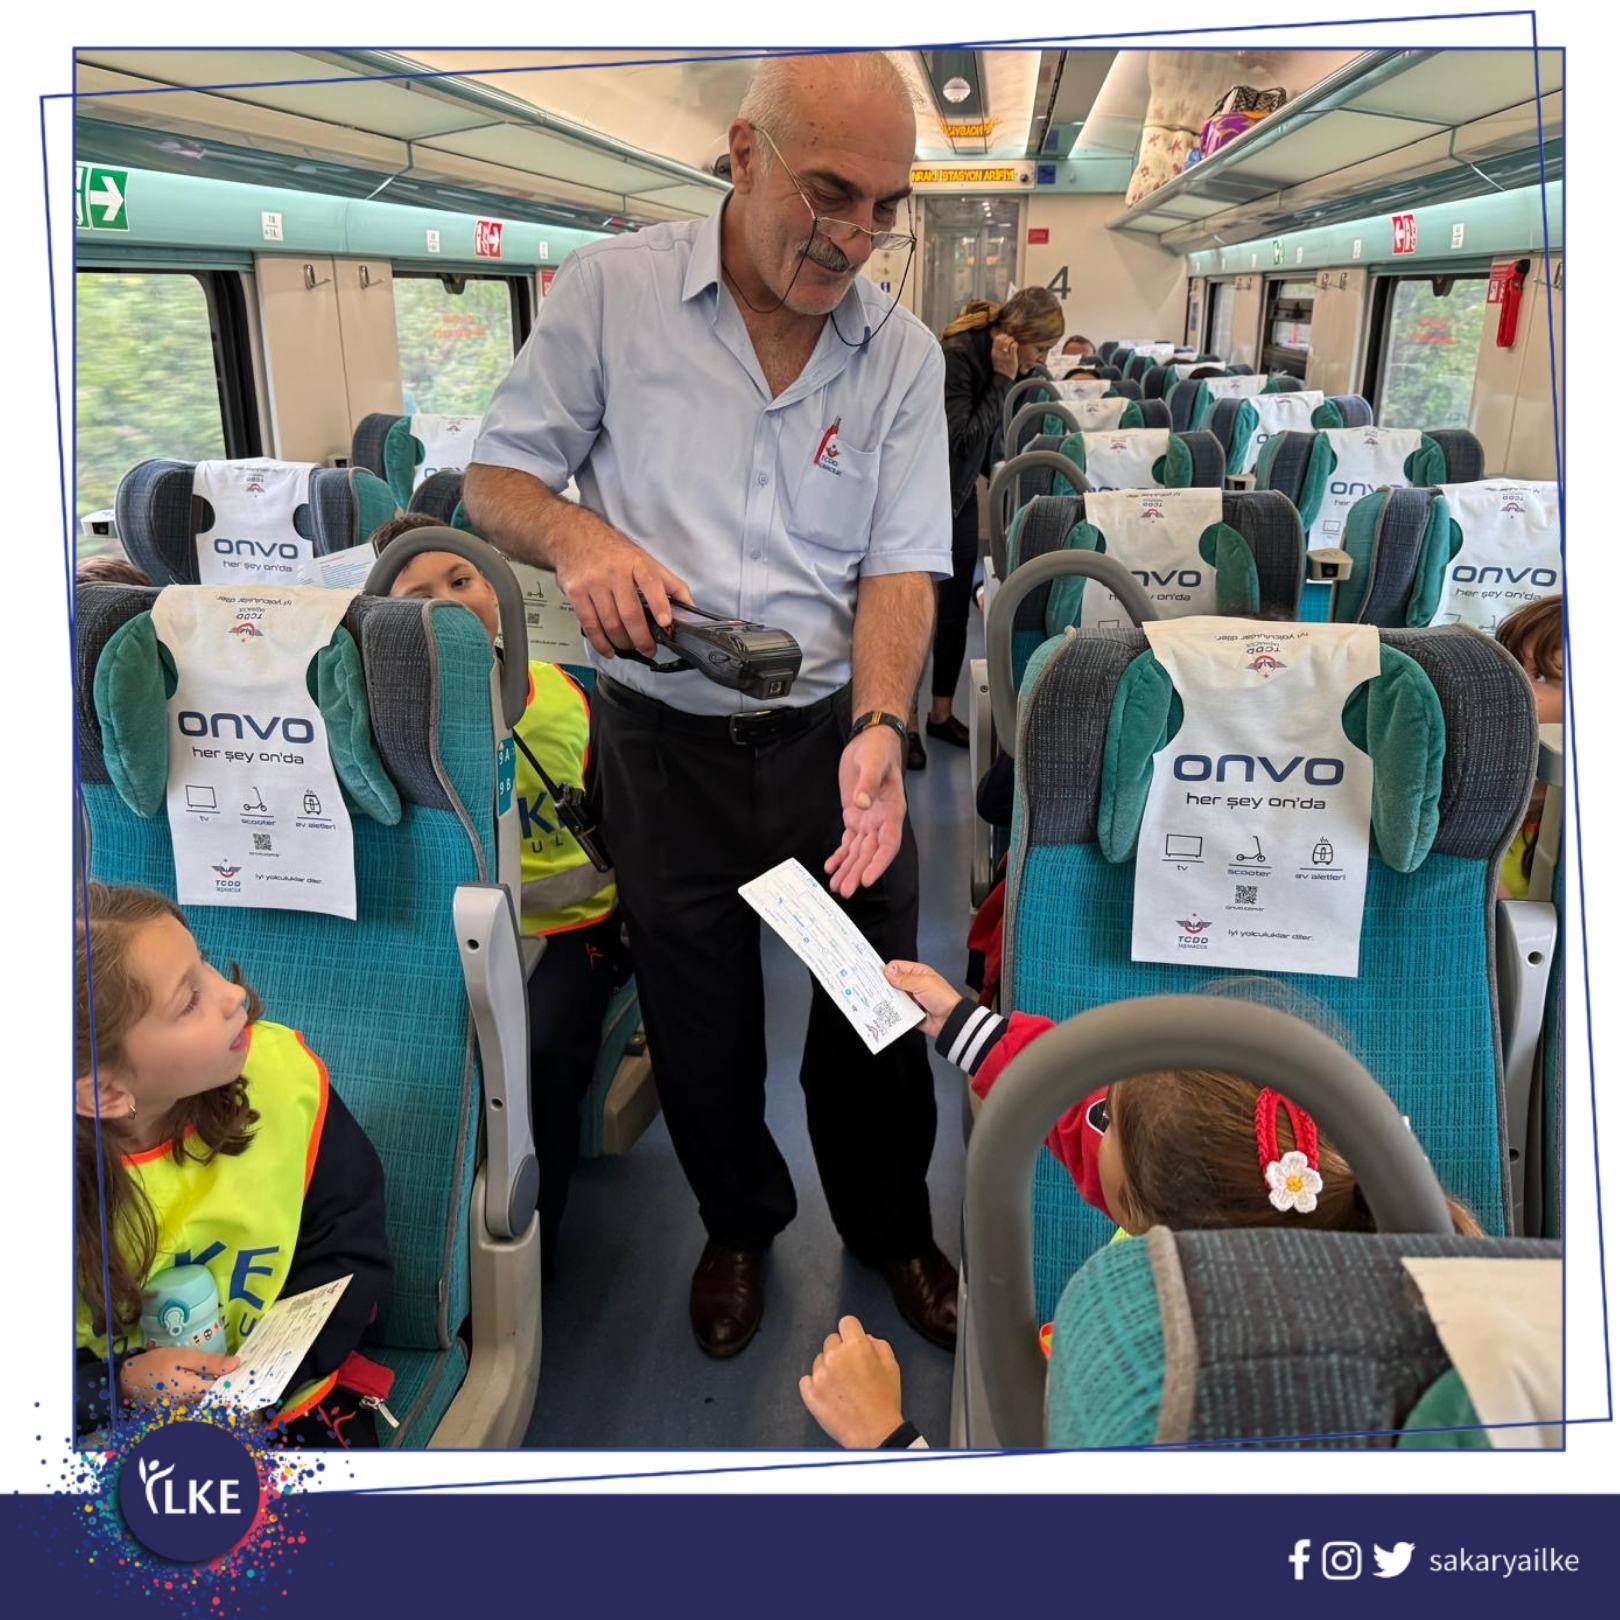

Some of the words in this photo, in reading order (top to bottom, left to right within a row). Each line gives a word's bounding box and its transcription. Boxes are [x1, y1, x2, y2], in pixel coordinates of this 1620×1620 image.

[1047, 265, 1071, 299] 4
[214, 539, 298, 559] onvo
[223, 559, 242, 568] her
[1452, 565, 1557, 588] onvo
[1157, 593, 1191, 602] on'da
[1455, 588, 1479, 596] her
[1246, 646, 1280, 654] TCDD
[178, 711, 315, 744] onvo
[192, 746, 220, 758] her
[225, 751, 254, 764] şey
[259, 752, 304, 764] on'da
[1173, 754, 1345, 786] onvo
[1186, 792, 1222, 806] her
[1226, 796, 1263, 810] şey
[1268, 796, 1326, 810] on'da
[1177, 864, 1188, 872] tv
[1227, 869, 1272, 878] scooter
[1178, 936, 1209, 944] TCDD
